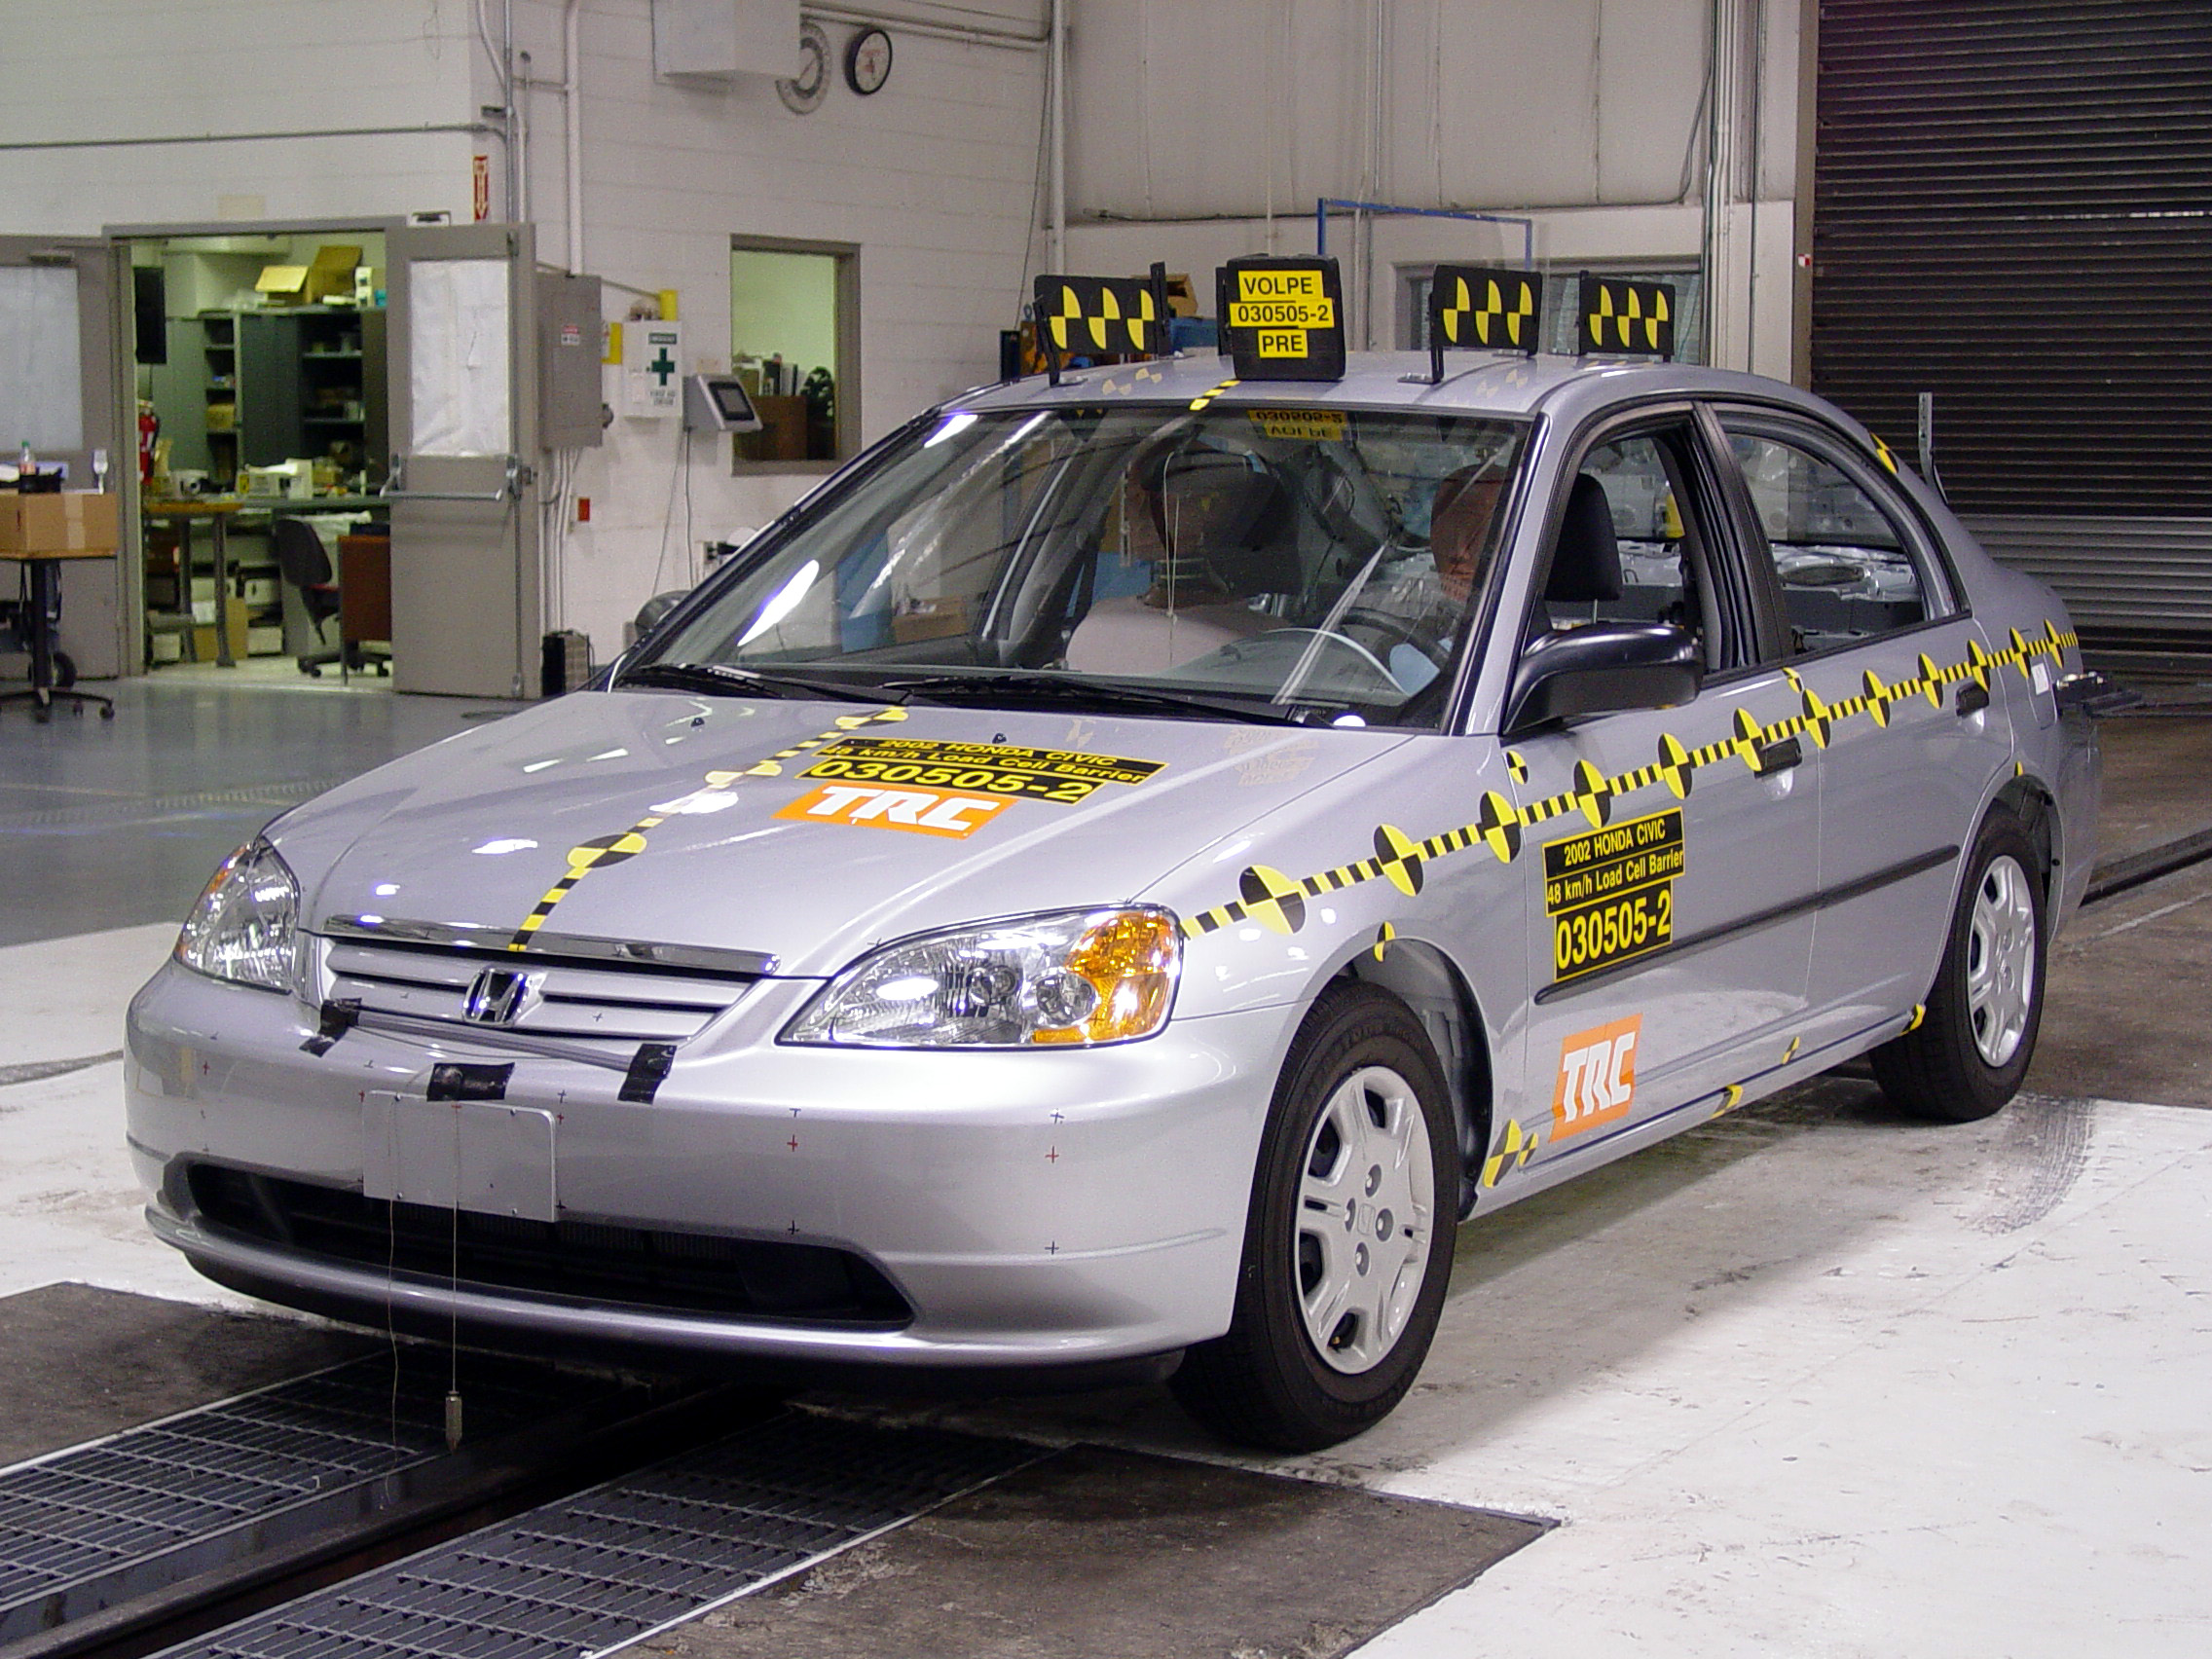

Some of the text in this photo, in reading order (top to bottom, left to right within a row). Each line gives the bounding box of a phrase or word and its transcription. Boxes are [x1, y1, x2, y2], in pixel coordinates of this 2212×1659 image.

[1243, 276, 1313, 295] VOLPE
[1237, 304, 1329, 322] 030505-2
[1262, 335, 1304, 352] PRE
[859, 748, 921, 759] km/h
[927, 752, 993, 764] Load
[998, 757, 1050, 770] Cell
[1053, 763, 1147, 783] Barrier
[944, 743, 1035, 757] HONDA
[1045, 752, 1118, 766] CIVIC
[810, 760, 1093, 801] 030505-2
[806, 786, 1000, 831] TRC
[1564, 818, 1666, 866] 2002 HONDA CIVIC
[1547, 849, 1683, 905] 48 km/h Load Cell Barrier
[1557, 889, 1672, 970] 030505-2
[1563, 1031, 1636, 1124] TRC
